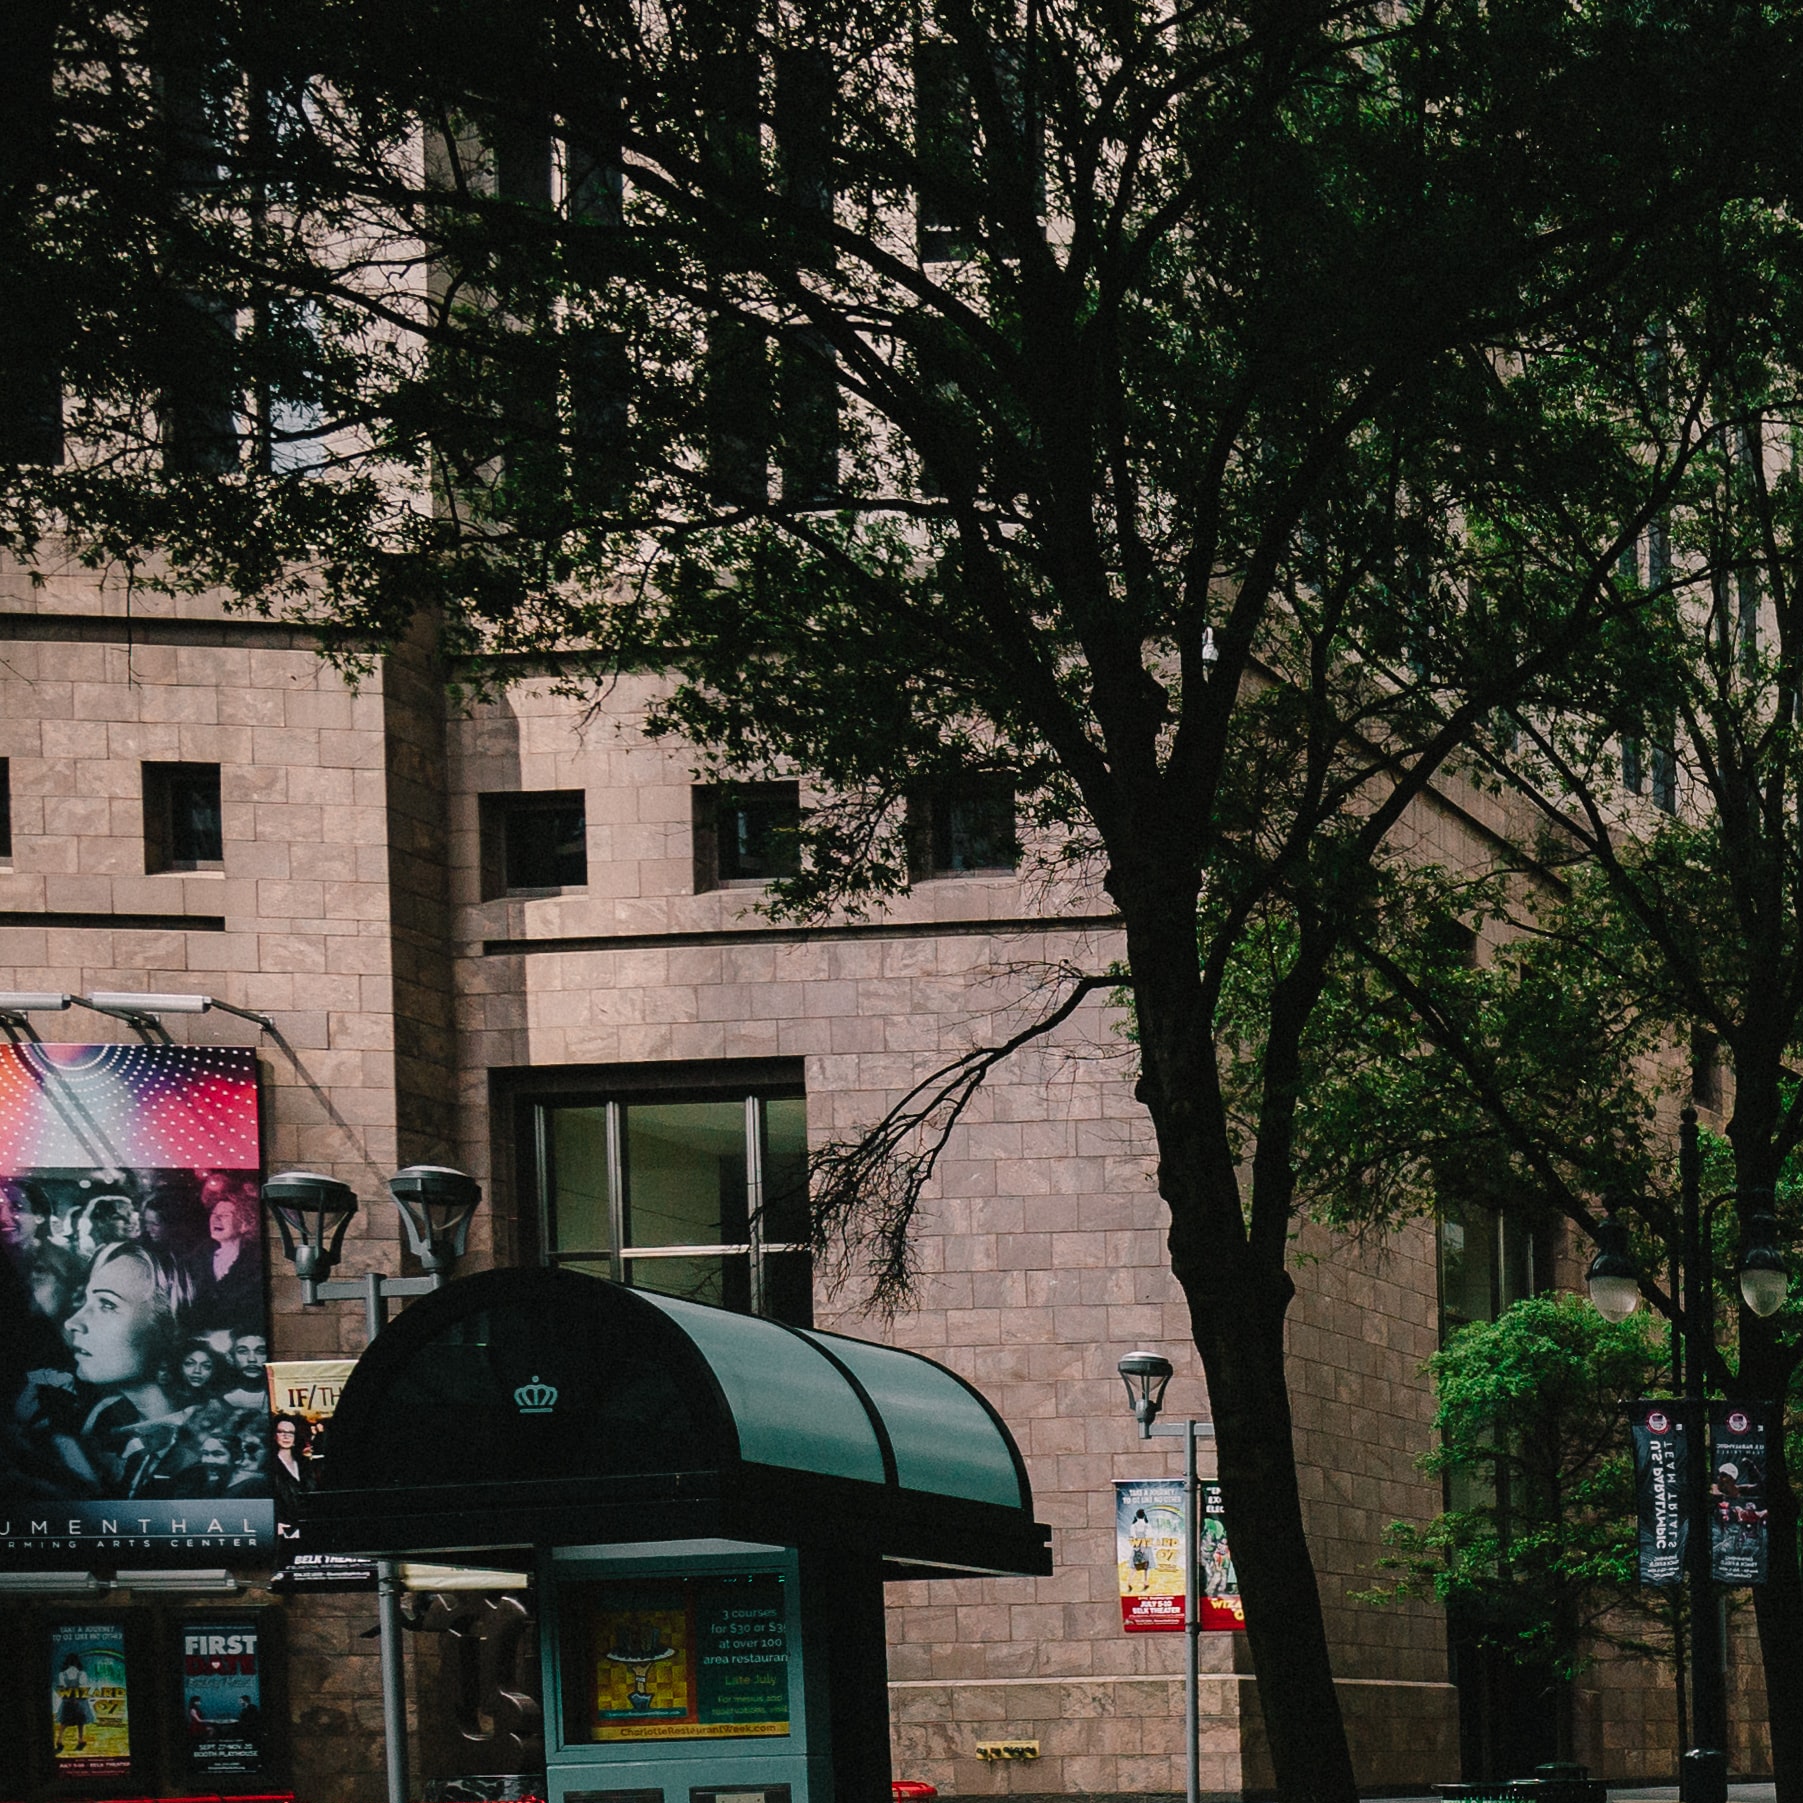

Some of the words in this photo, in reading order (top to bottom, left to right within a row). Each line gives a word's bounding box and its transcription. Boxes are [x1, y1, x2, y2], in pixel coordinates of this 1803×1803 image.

[97, 1539, 151, 1548] ARTS
[170, 1538, 257, 1548] CENTER
[731, 1608, 778, 1618] courses
[711, 1623, 727, 1634] for
[729, 1622, 751, 1635] $30
[753, 1624, 765, 1632] or
[184, 1635, 258, 1655] FIRST
[718, 1639, 730, 1649] at
[732, 1640, 758, 1649] over
[761, 1638, 782, 1648] 100
[703, 1655, 729, 1665] area
[731, 1652, 791, 1664] restauran
[620, 1723, 777, 1737] CharlotteRestaurantWeek.com
